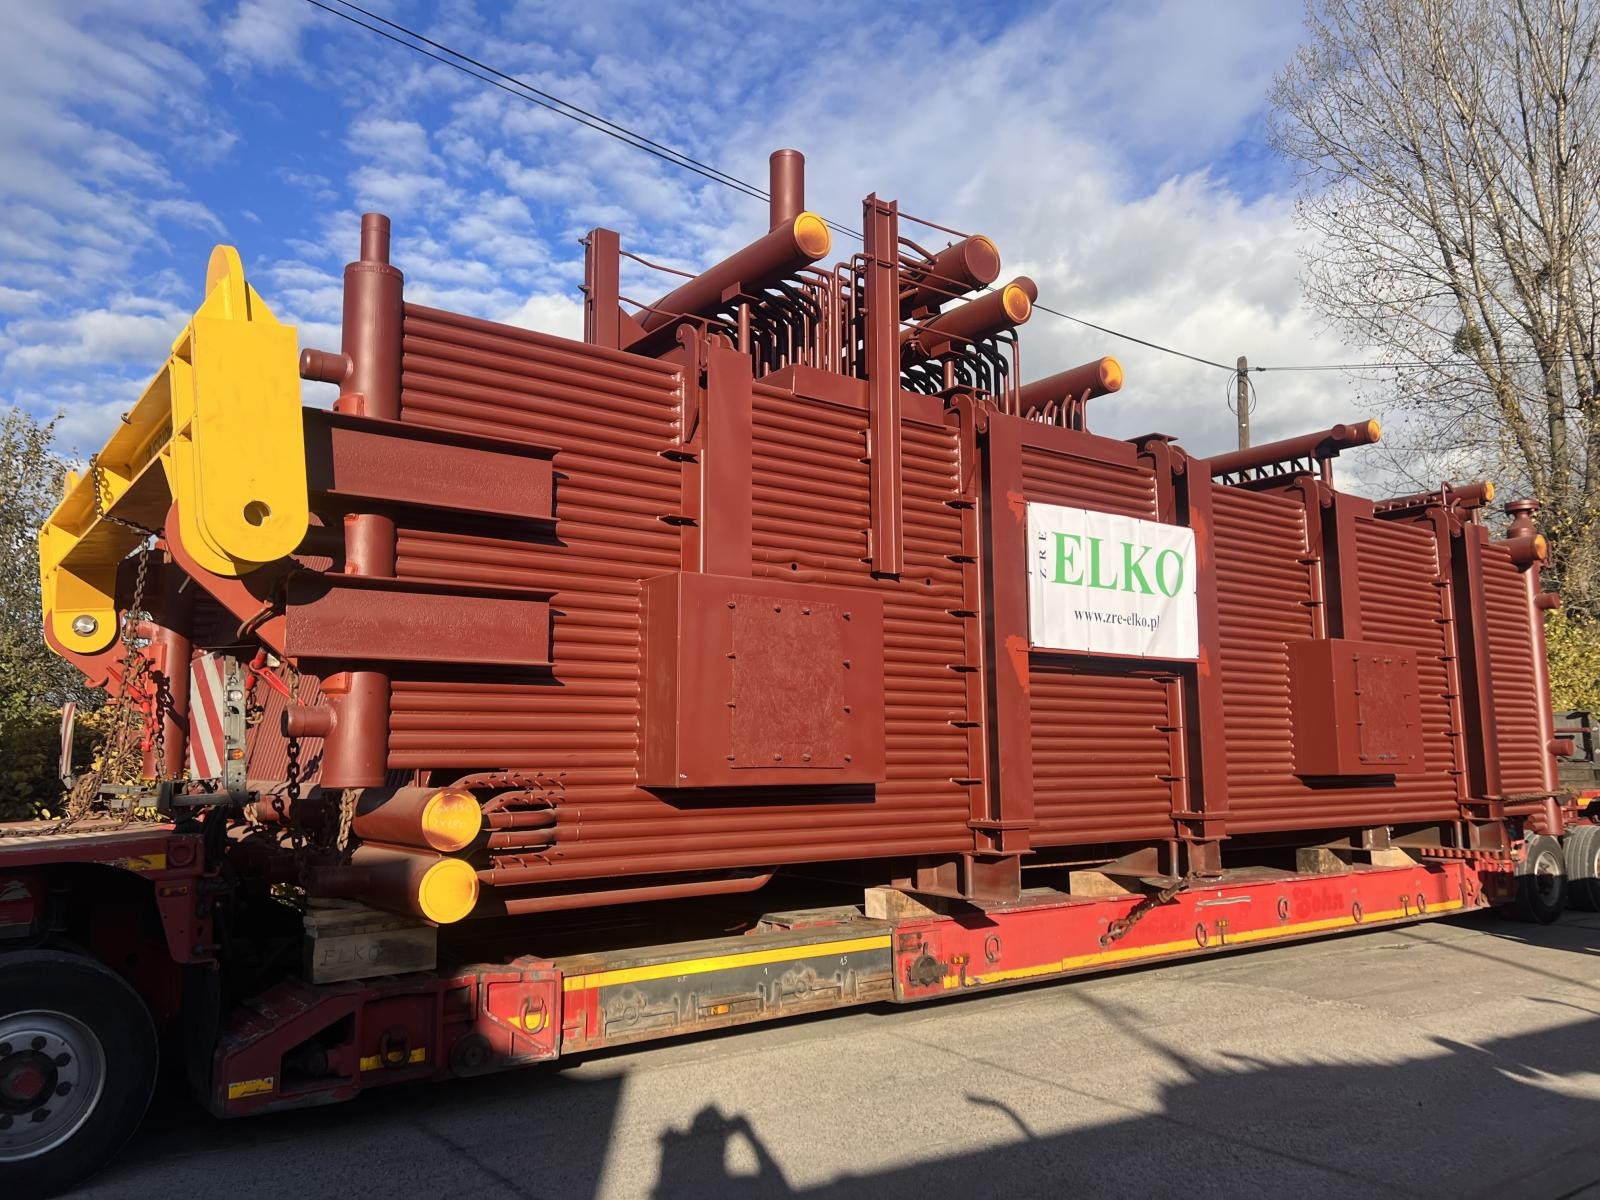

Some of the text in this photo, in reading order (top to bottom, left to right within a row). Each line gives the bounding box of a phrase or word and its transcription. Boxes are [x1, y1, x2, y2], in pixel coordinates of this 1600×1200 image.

[1038, 531, 1047, 579] ZRE
[1051, 531, 1184, 598] ELKO
[1074, 610, 1160, 632] www.zre-elko.pl
